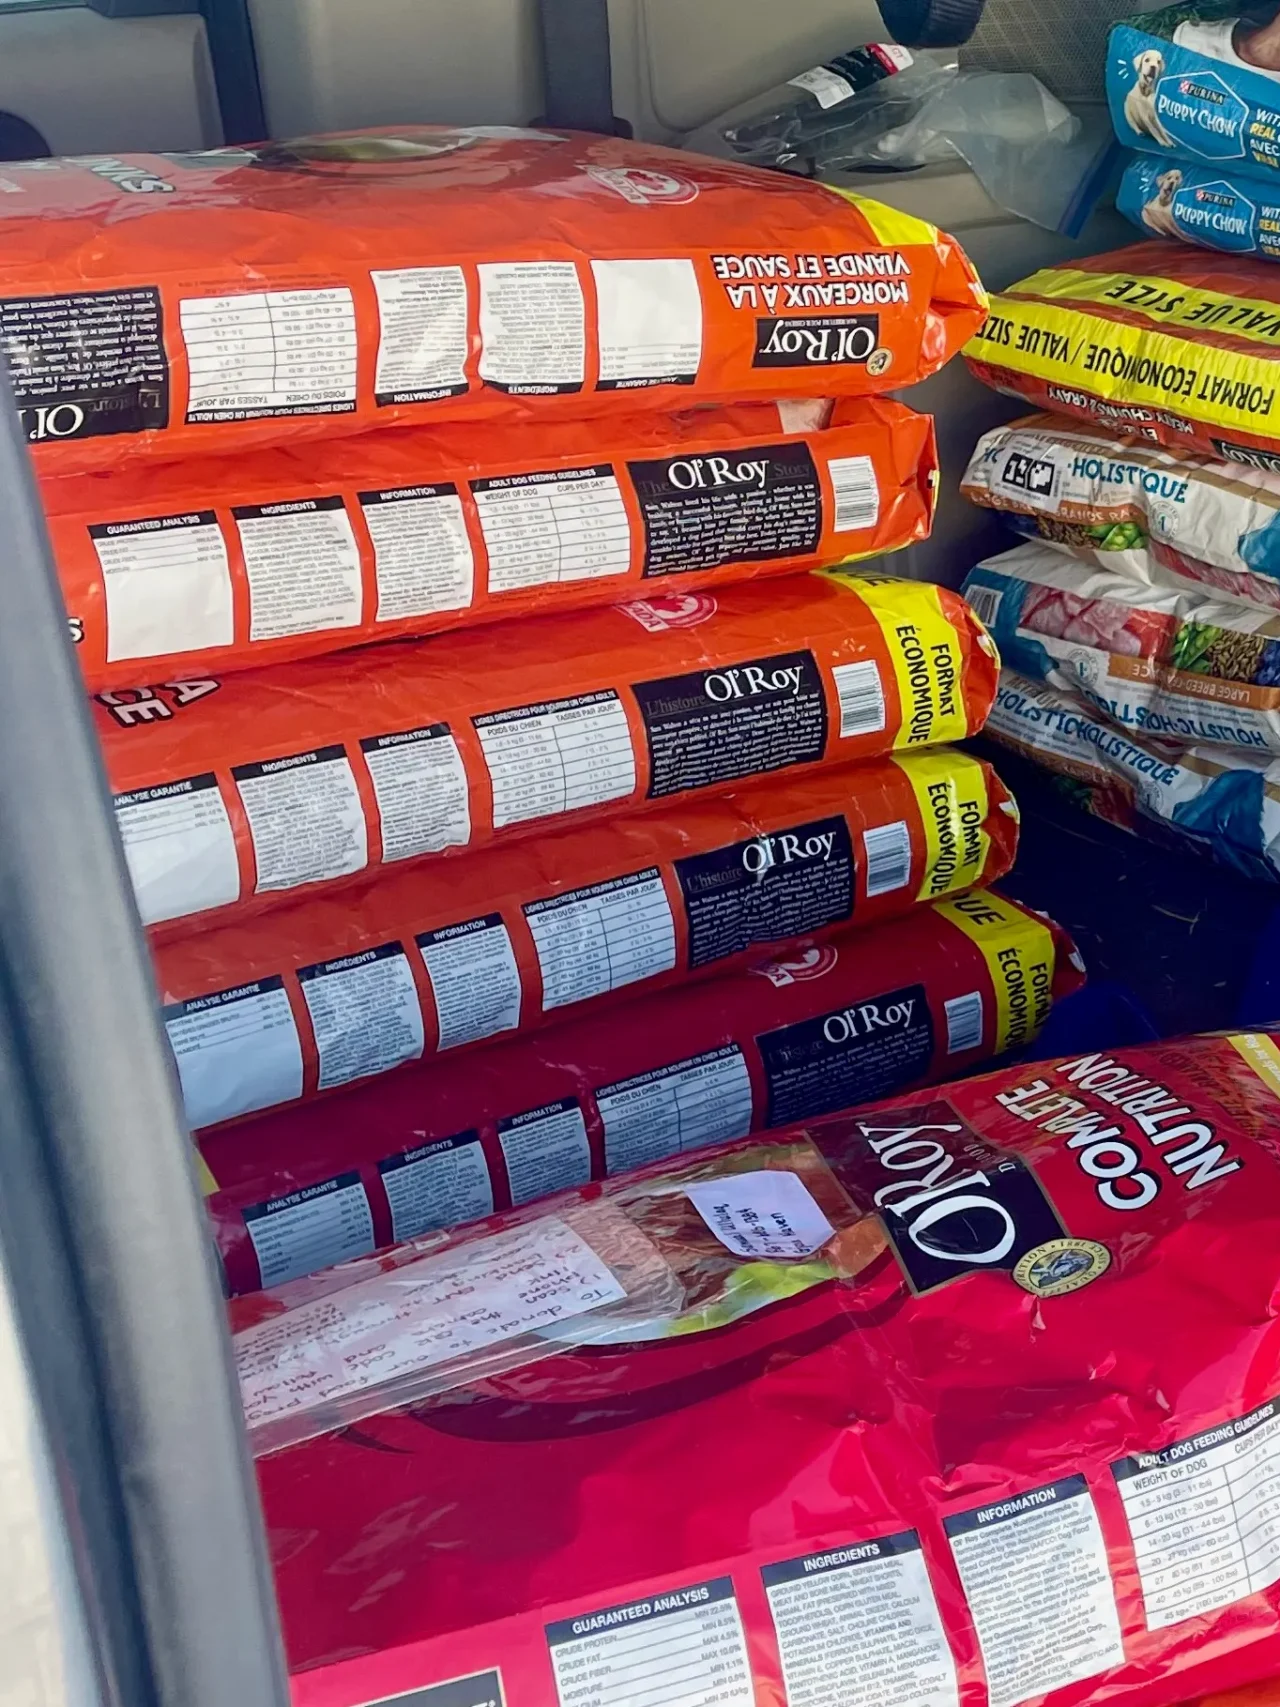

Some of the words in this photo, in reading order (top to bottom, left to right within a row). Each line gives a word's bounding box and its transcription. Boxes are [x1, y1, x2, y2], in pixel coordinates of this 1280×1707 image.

[1188, 83, 1225, 104] PURINA
[1159, 96, 1197, 129] PUPPY
[1198, 109, 1237, 138] CHOW
[1250, 123, 1276, 141] REAL
[1250, 139, 1280, 157] AVEC
[1253, 152, 1279, 169] VRAI
[1204, 193, 1235, 206] PURINA
[1176, 204, 1211, 229] PUPPY
[1212, 213, 1248, 235] CHOW
[713, 256, 790, 279] SAUCE
[795, 254, 821, 277] ET
[823, 253, 911, 275] VIANDE
[727, 284, 758, 309] LA
[763, 283, 780, 314] À
[786, 282, 909, 305] MORCEAUX
[1105, 280, 1185, 316] SIZE
[974, 317, 1015, 347] SIZE
[1016, 327, 1069, 362] VALUE
[1084, 344, 1197, 404] ÉCONOMIQUE
[393, 389, 452, 402] INFORMATION
[1198, 371, 1275, 414] FORMAT
[510, 477, 525, 488] DOG
[527, 473, 559, 485] FEEDING
[559, 468, 597, 481] GUIDELINES
[380, 487, 436, 500] INFORMATION
[261, 501, 316, 515] INGREDIENTS
[107, 521, 159, 534] GUARANTEED
[161, 515, 200, 527] ANALYSIS
[896, 624, 933, 745] ÉCONOMIQUE
[930, 643, 956, 718] FORMAT
[378, 730, 431, 746] INFORMATION
[262, 754, 317, 771] INGRÉDIENTS
[927, 782, 954, 895] ÉCONOMIQUE
[433, 919, 486, 941] INFORMATION
[513, 1103, 562, 1126] INFORMATION
[1056, 1053, 1243, 1190] NUTRITION
[996, 1080, 1161, 1210] COMPLETE
[304, 1180, 338, 1200] GARANTIE
[1139, 1453, 1170, 1469] ADULT
[1170, 1443, 1193, 1459] DOG
[1193, 1426, 1234, 1448] FEEDING
[1234, 1404, 1274, 1433] GUIDELINES
[1133, 1471, 1168, 1490] WEIGHT
[1170, 1467, 1185, 1479] OF
[1187, 1458, 1208, 1474] DOG
[977, 1488, 1056, 1523] INFORMATION
[803, 1543, 880, 1572] INGREDIENTS
[572, 1603, 651, 1634] GUARANTEED
[653, 1587, 710, 1612] ANALYSIS
